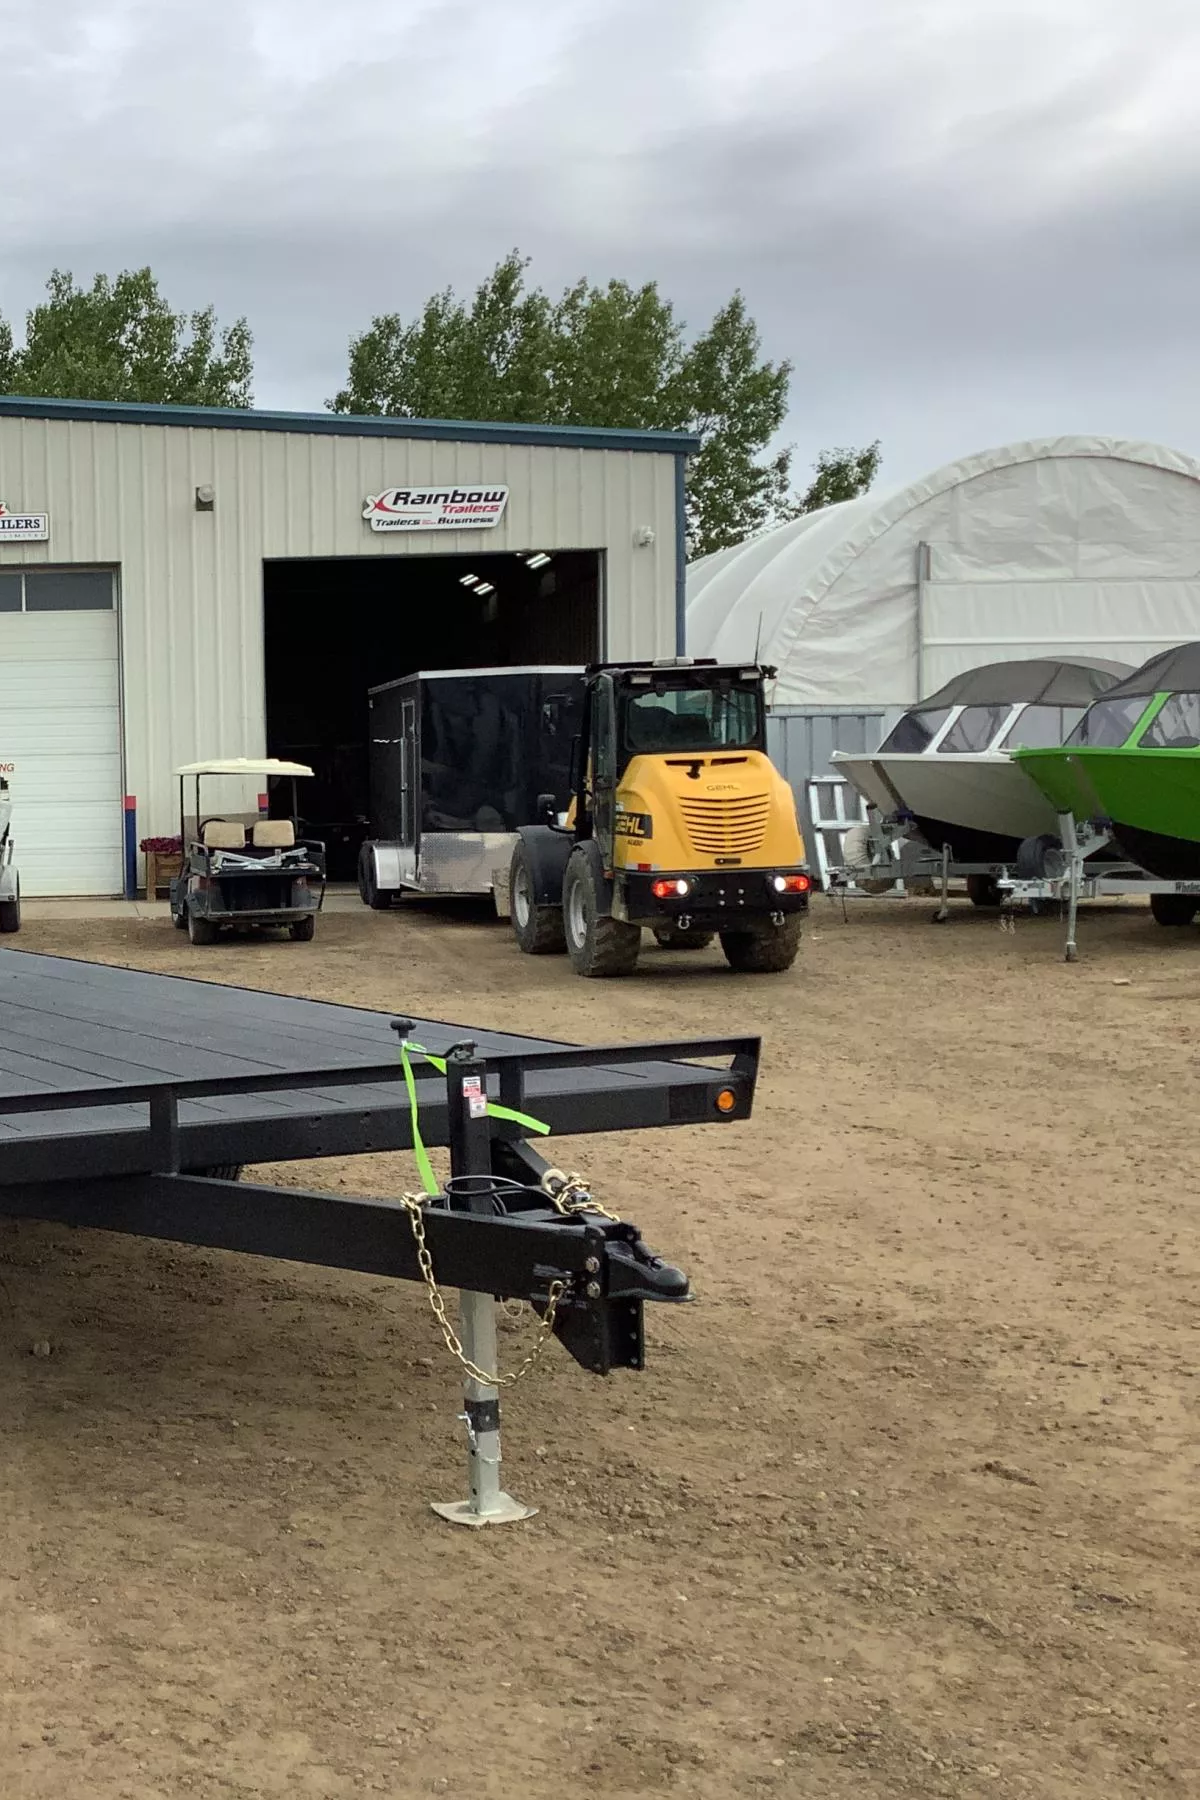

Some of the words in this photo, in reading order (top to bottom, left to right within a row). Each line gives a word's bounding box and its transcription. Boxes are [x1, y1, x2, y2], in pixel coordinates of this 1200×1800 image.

[392, 489, 506, 506] Rainbow
[441, 504, 500, 514] Trailers
[375, 518, 420, 527] Trailers
[437, 516, 494, 525] Business
